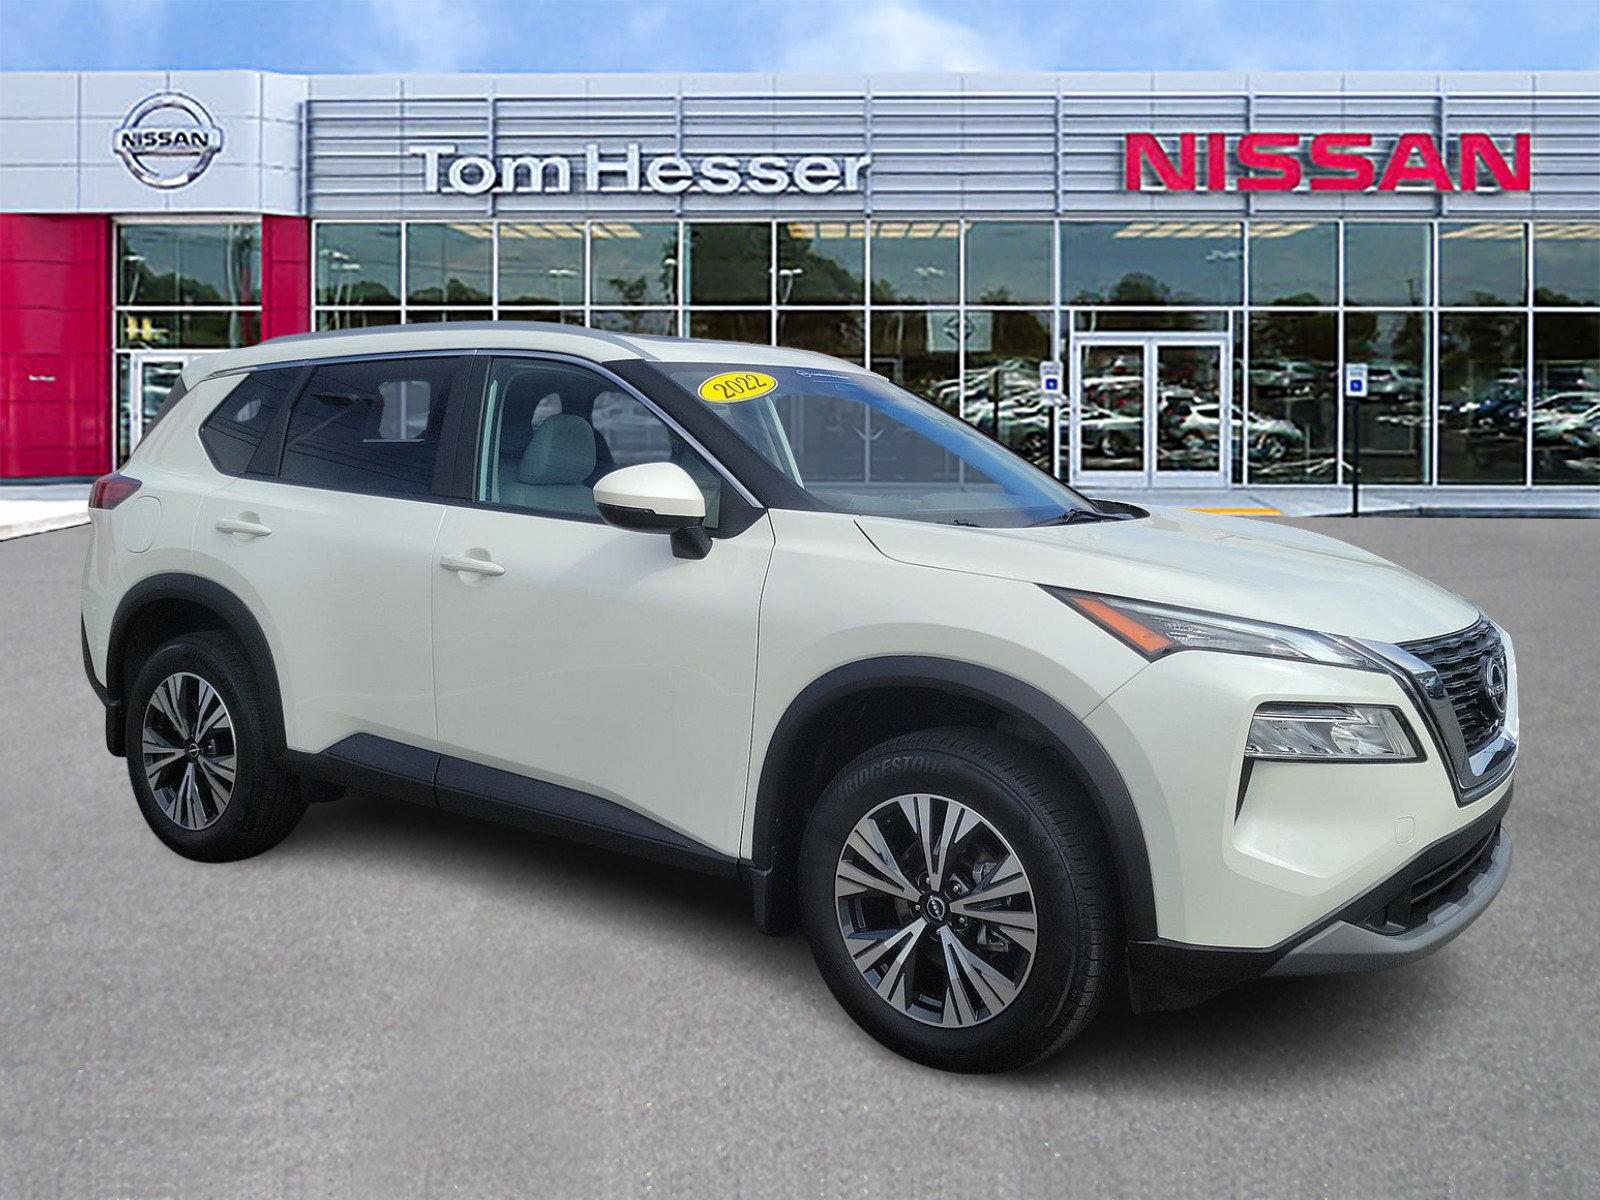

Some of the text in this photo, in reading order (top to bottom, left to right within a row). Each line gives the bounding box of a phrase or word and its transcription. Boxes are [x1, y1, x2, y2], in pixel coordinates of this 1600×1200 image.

[121, 131, 209, 147] NISSAN
[409, 143, 871, 194] Tom Hesser
[1125, 132, 1531, 191] NISSAN
[713, 374, 767, 399] 2022
